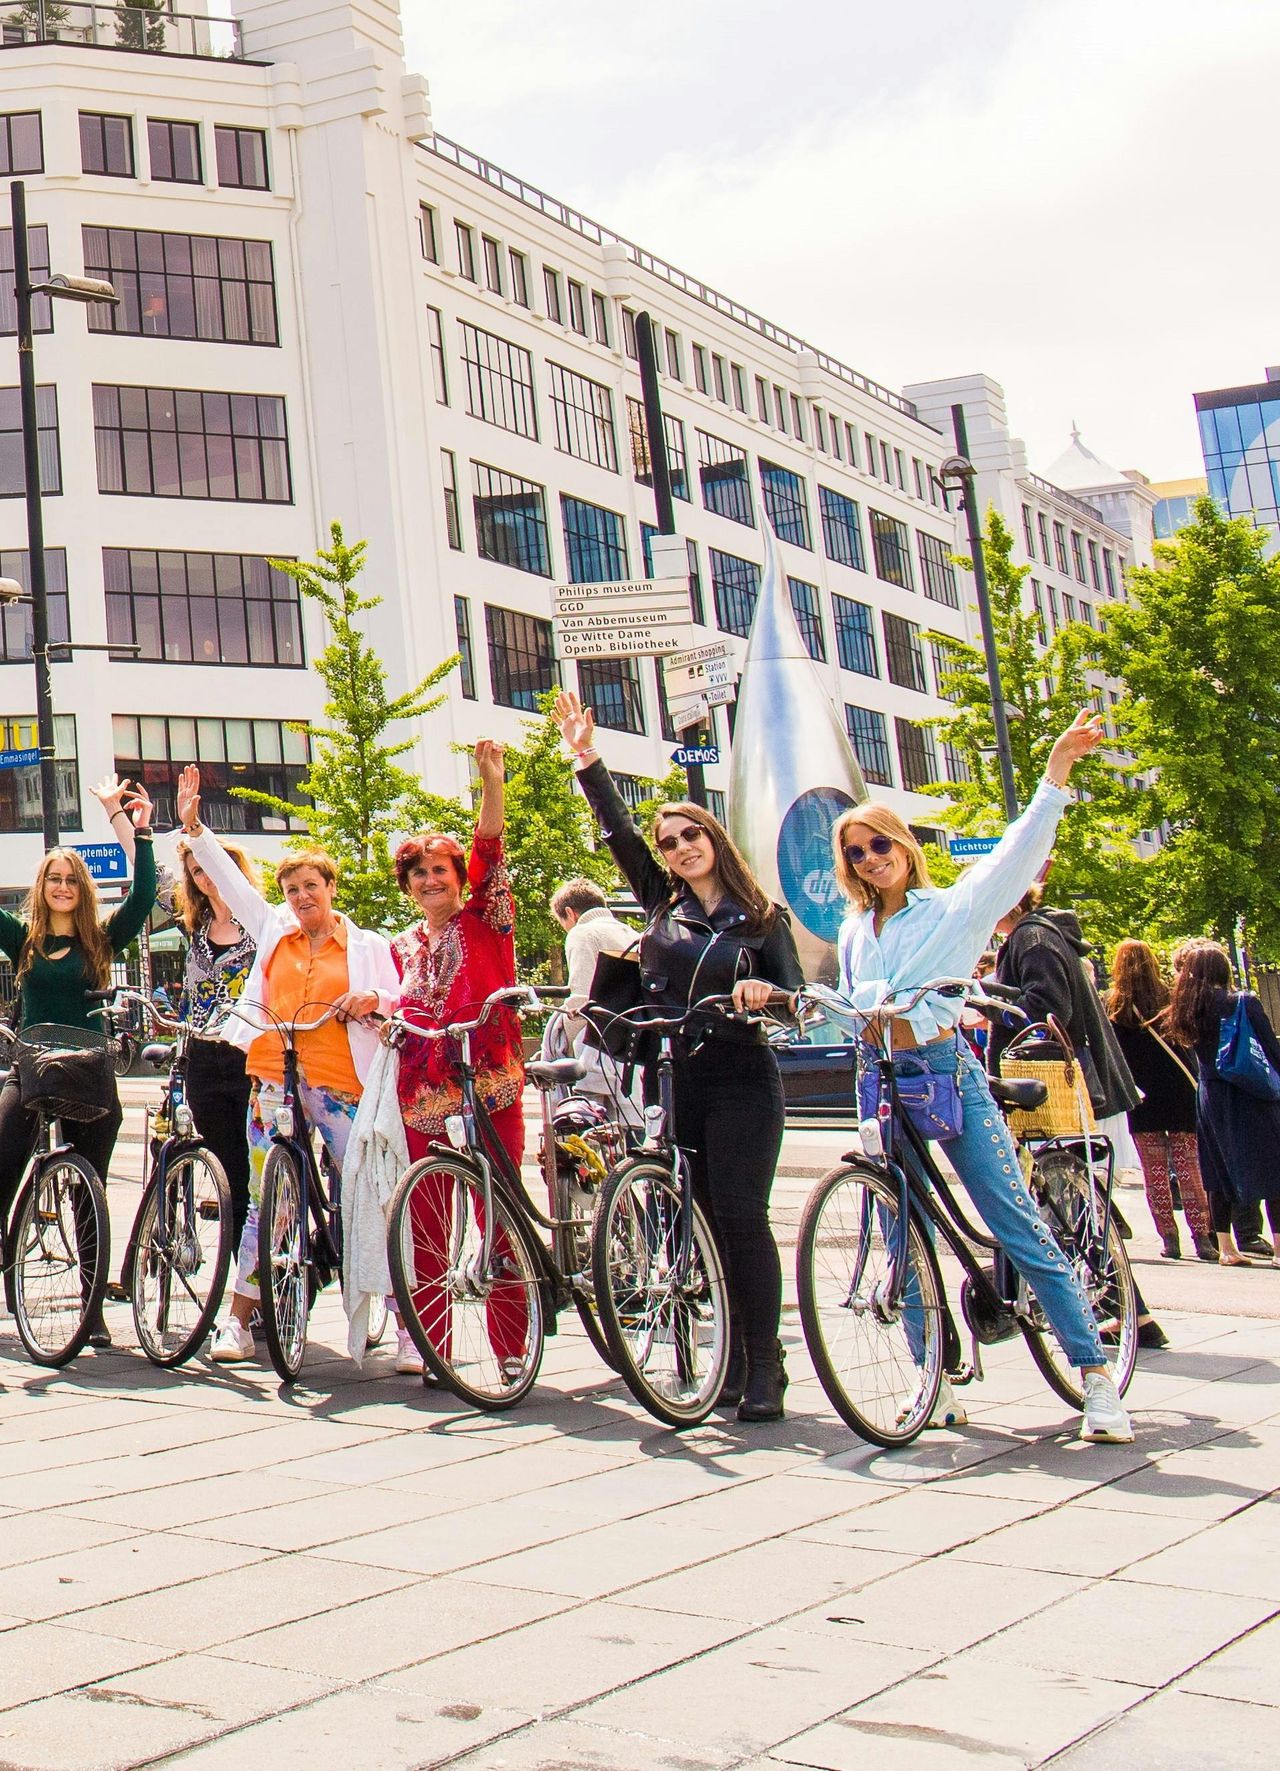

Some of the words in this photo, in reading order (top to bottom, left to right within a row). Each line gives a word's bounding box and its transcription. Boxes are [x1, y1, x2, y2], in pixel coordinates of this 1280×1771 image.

[558, 586, 599, 597] Philips
[603, 583, 653, 594] museum
[559, 602, 584, 612] GGD
[562, 619, 584, 628] Van
[587, 613, 668, 626] Abbemuseum
[563, 633, 578, 643] De
[581, 631, 614, 641] Witte
[618, 630, 651, 639] Dame
[564, 643, 606, 655] Openb.
[609, 638, 679, 651] Bibliotheek
[670, 651, 697, 665] Admirant
[697, 644, 726, 658] shopping
[705, 660, 726, 673] Station
[715, 673, 728, 683] VVV
[0, 750, 38, 765] Emmasingel
[677, 747, 718, 764] DEMOS
[74, 846, 121, 860] eptember-
[84, 862, 102, 874] lein
